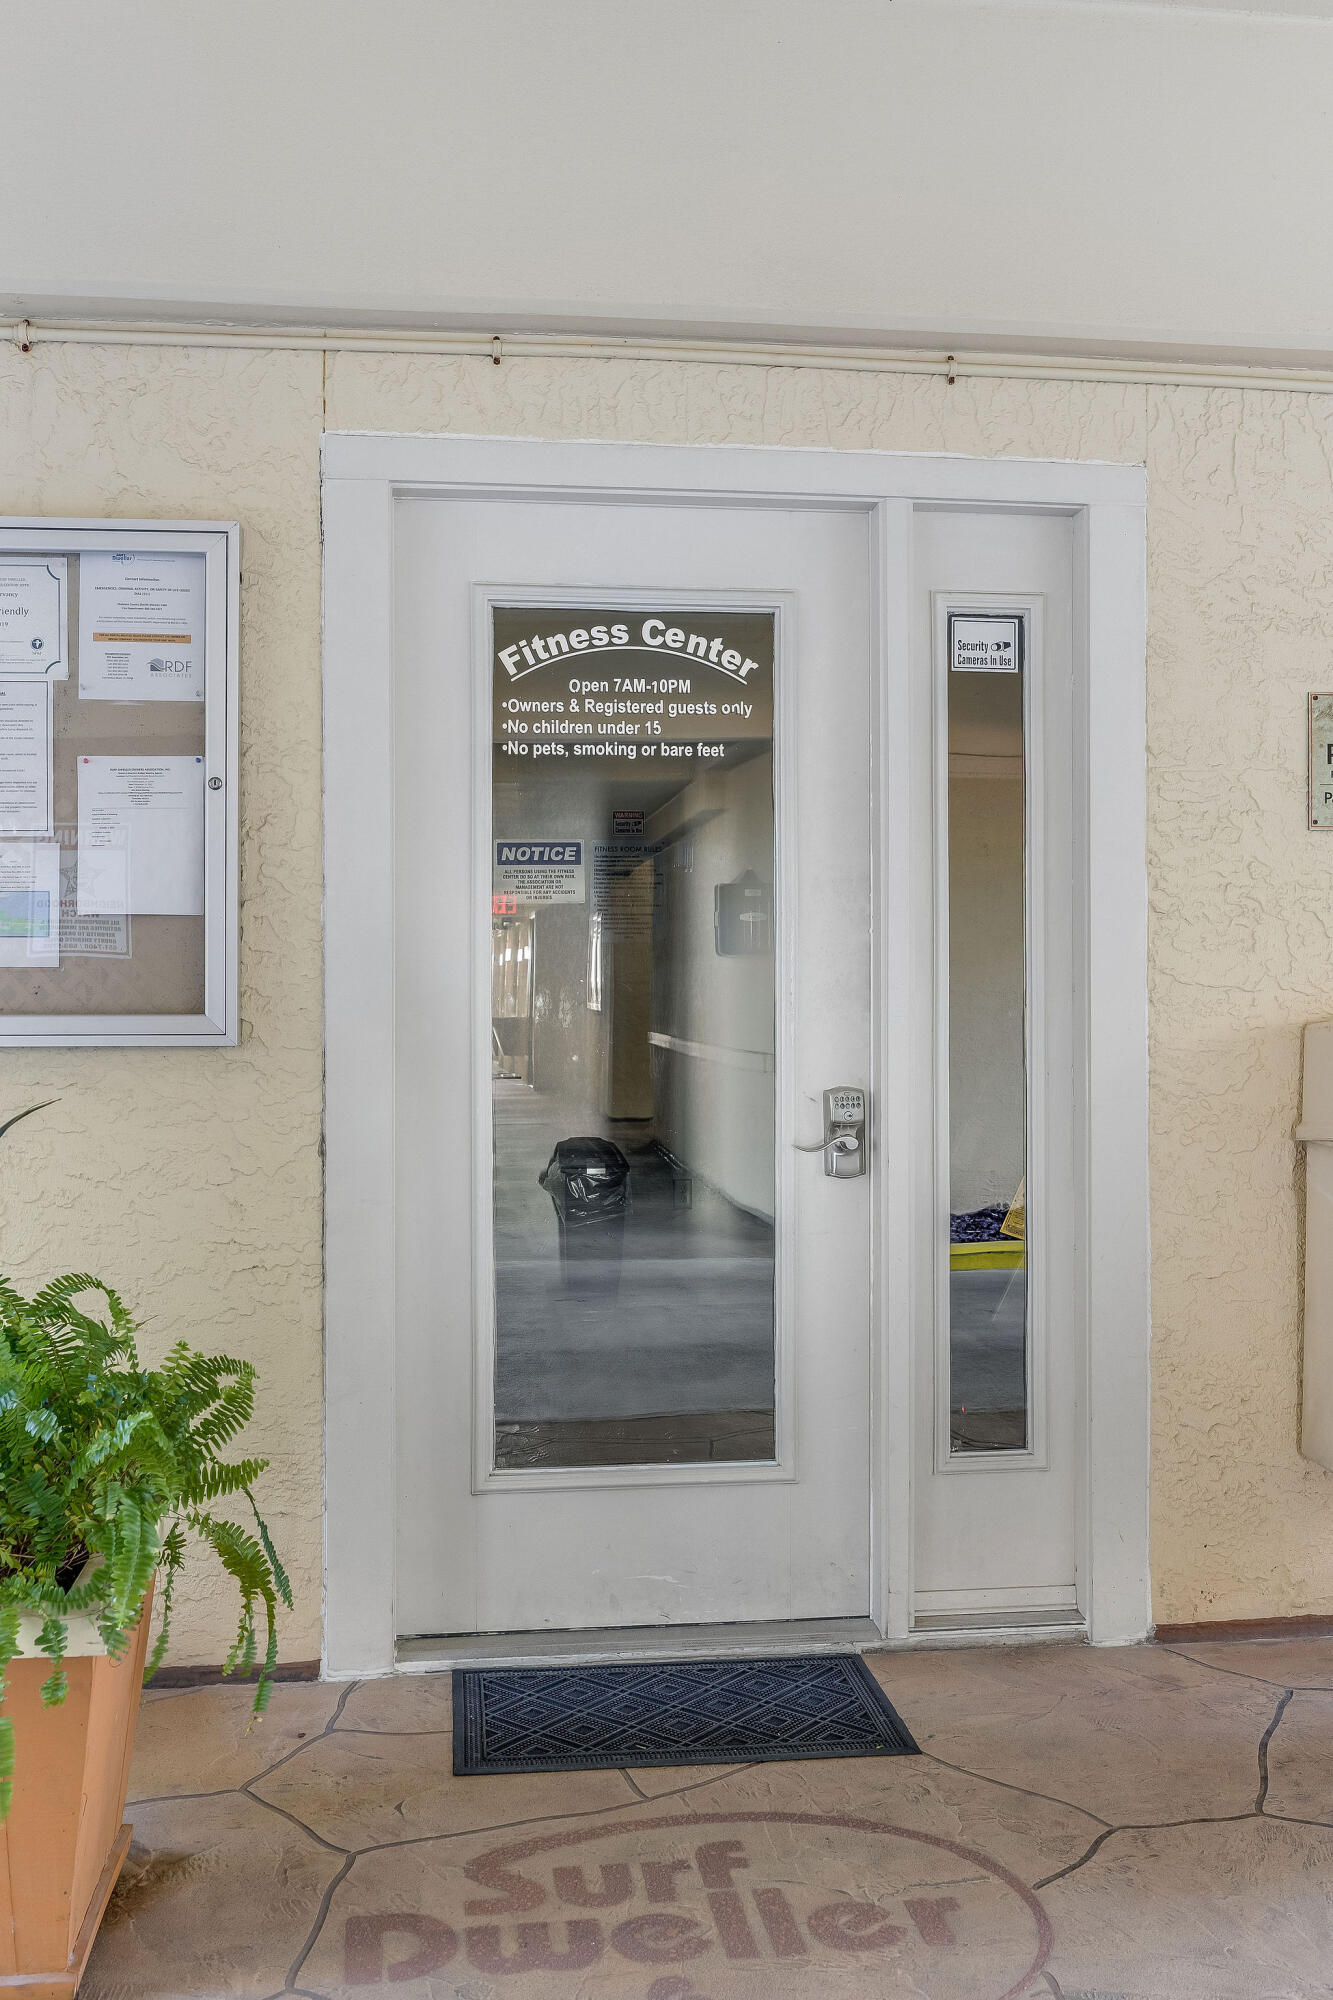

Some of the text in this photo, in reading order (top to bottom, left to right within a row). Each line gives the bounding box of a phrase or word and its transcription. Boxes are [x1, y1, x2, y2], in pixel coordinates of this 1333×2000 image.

[498, 619, 759, 678] Fitness Center
[957, 640, 989, 654] Security
[164, 661, 192, 673] RDF
[957, 654, 1012, 666] Cameras In Use
[569, 679, 691, 695] Open 7AM-10PM
[569, 699, 580, 713] &
[585, 699, 664, 716] Registered
[668, 701, 717, 717] guests
[722, 701, 753, 718] only
[533, 720, 592, 734] children
[598, 721, 640, 735] under
[645, 721, 662, 735] 15
[533, 742, 569, 758] pets,
[573, 742, 636, 759] smoking
[641, 745, 657, 756] or
[661, 742, 693, 756] bare
[697, 743, 725, 756] feet
[501, 846, 577, 861] NOTICE
[594, 845, 618, 853] FITNESS
[620, 845, 642, 853] ROOM
[463, 1839, 750, 1917] Surf
[344, 1887, 962, 1985] Dweller
